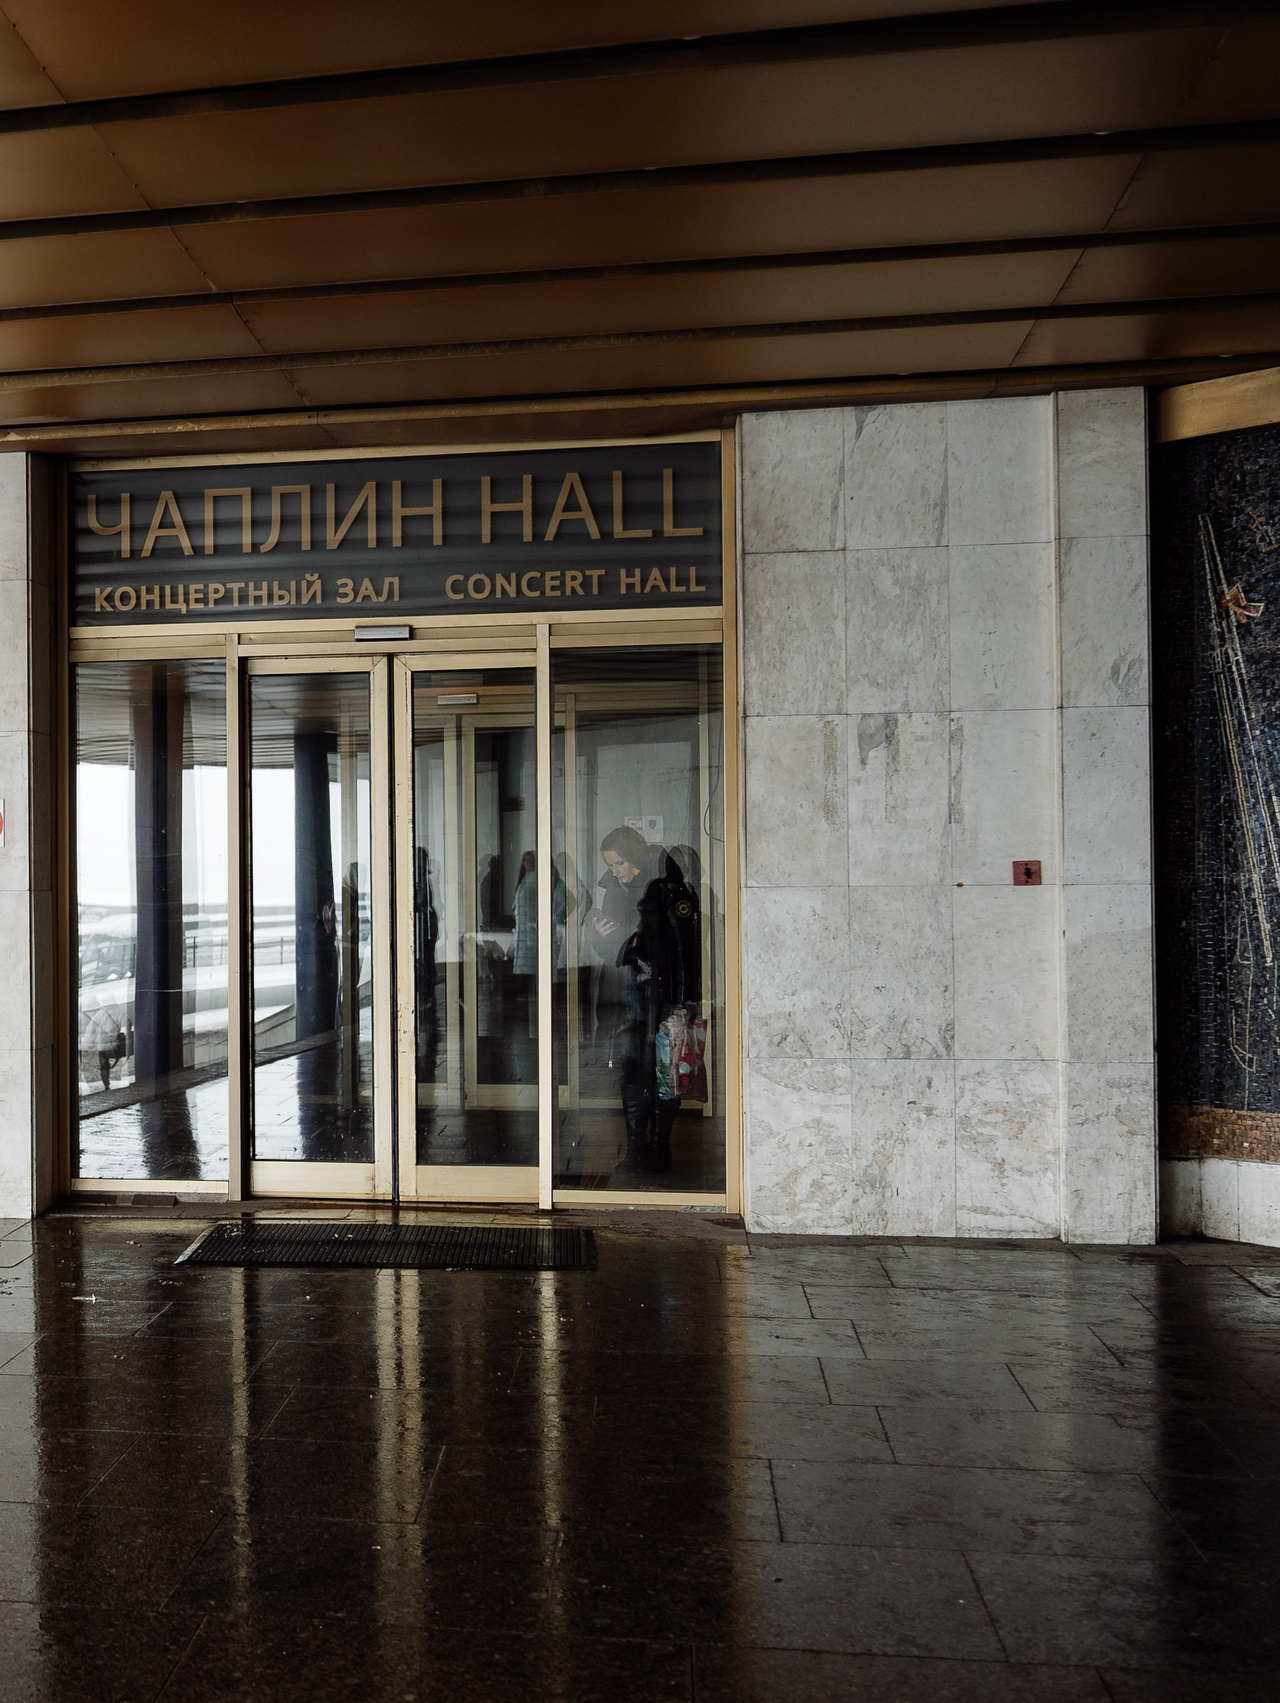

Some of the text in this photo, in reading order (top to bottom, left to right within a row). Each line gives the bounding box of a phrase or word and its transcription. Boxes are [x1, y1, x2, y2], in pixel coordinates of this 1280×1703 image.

[86, 467, 704, 559] ЧАПЛИН HALL
[94, 573, 400, 614] КОНЦЕРТНЫЙ ЗАЛ
[445, 566, 706, 600] CONCERT HALL
